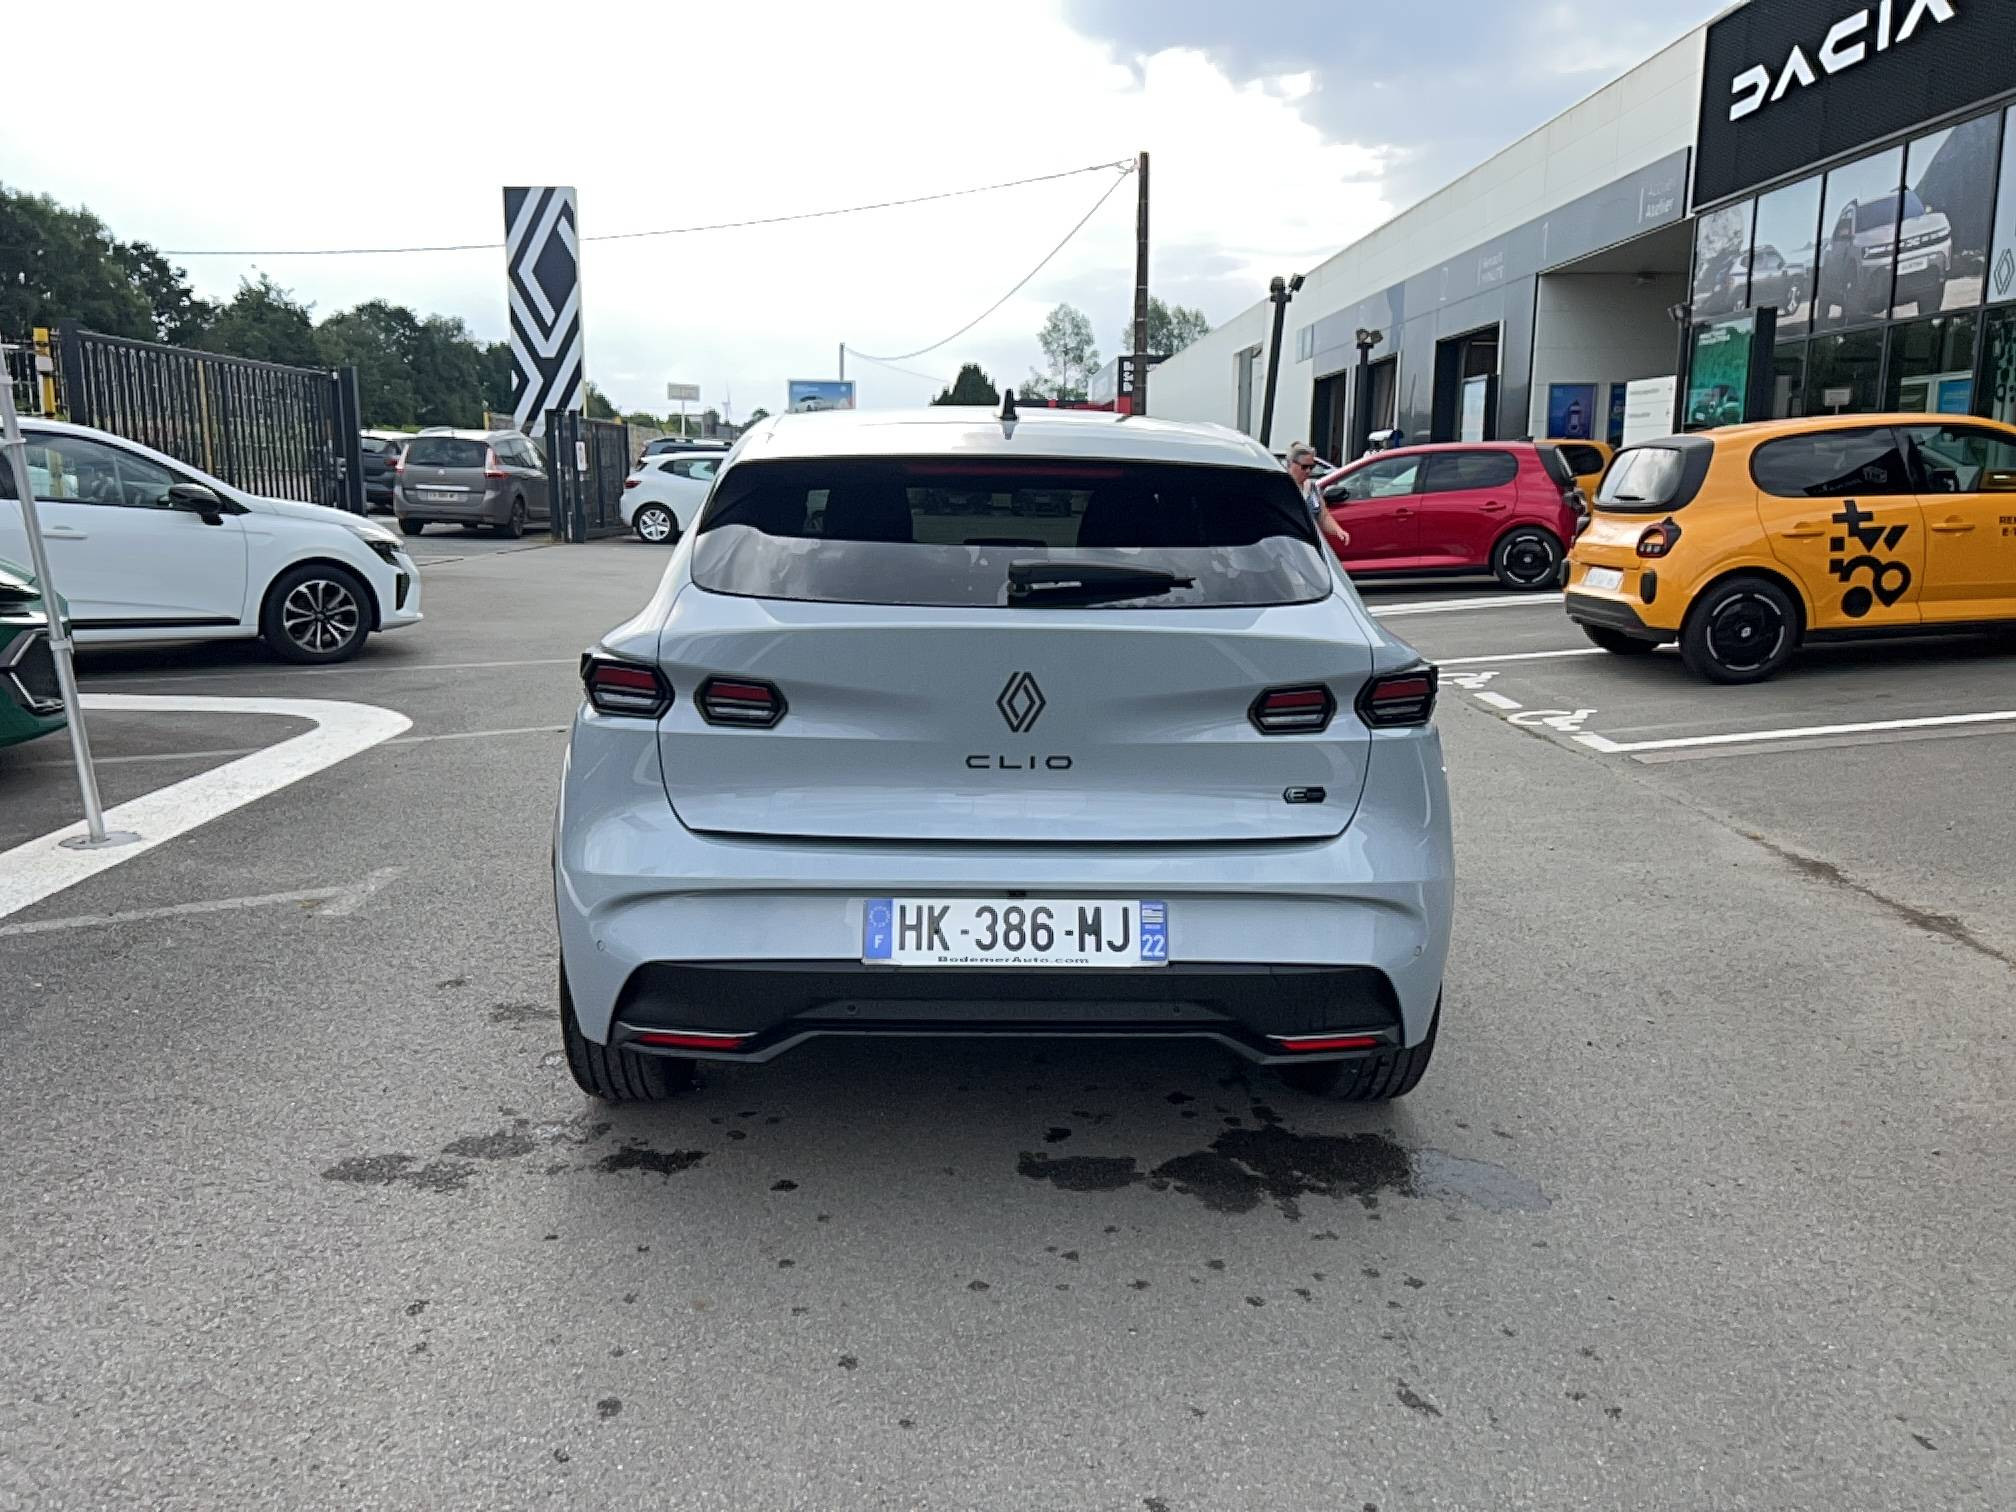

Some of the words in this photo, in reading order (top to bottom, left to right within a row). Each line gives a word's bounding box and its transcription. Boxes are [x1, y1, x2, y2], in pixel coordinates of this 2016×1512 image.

[1729, 0, 1955, 122] DACIA
[965, 755, 1073, 770] CLIO
[899, 904, 1130, 953] HK-386-MJ
[874, 934, 884, 949] F
[1142, 934, 1166, 956] 22
